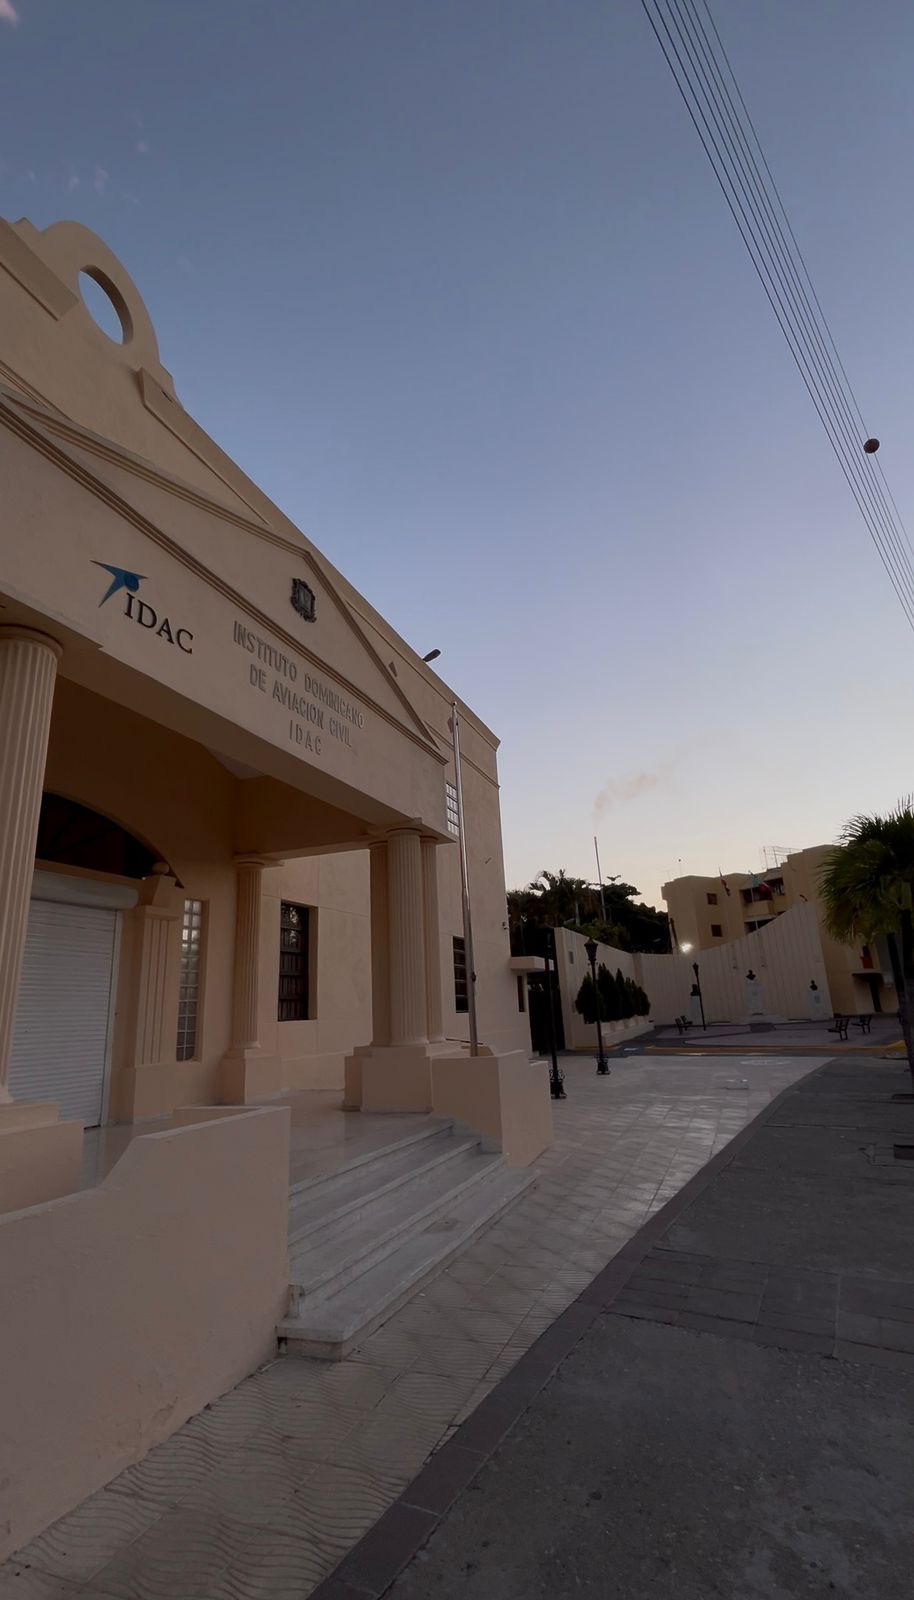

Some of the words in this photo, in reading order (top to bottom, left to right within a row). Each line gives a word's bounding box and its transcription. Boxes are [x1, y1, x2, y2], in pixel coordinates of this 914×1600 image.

[124, 592, 194, 654] IDAC
[233, 620, 298, 682] INSTITUTO
[304, 673, 364, 729] DOMINICANO
[249, 663, 267, 693] DE
[329, 717, 352, 748] CIVIL
[289, 719, 322, 755] IDAC
